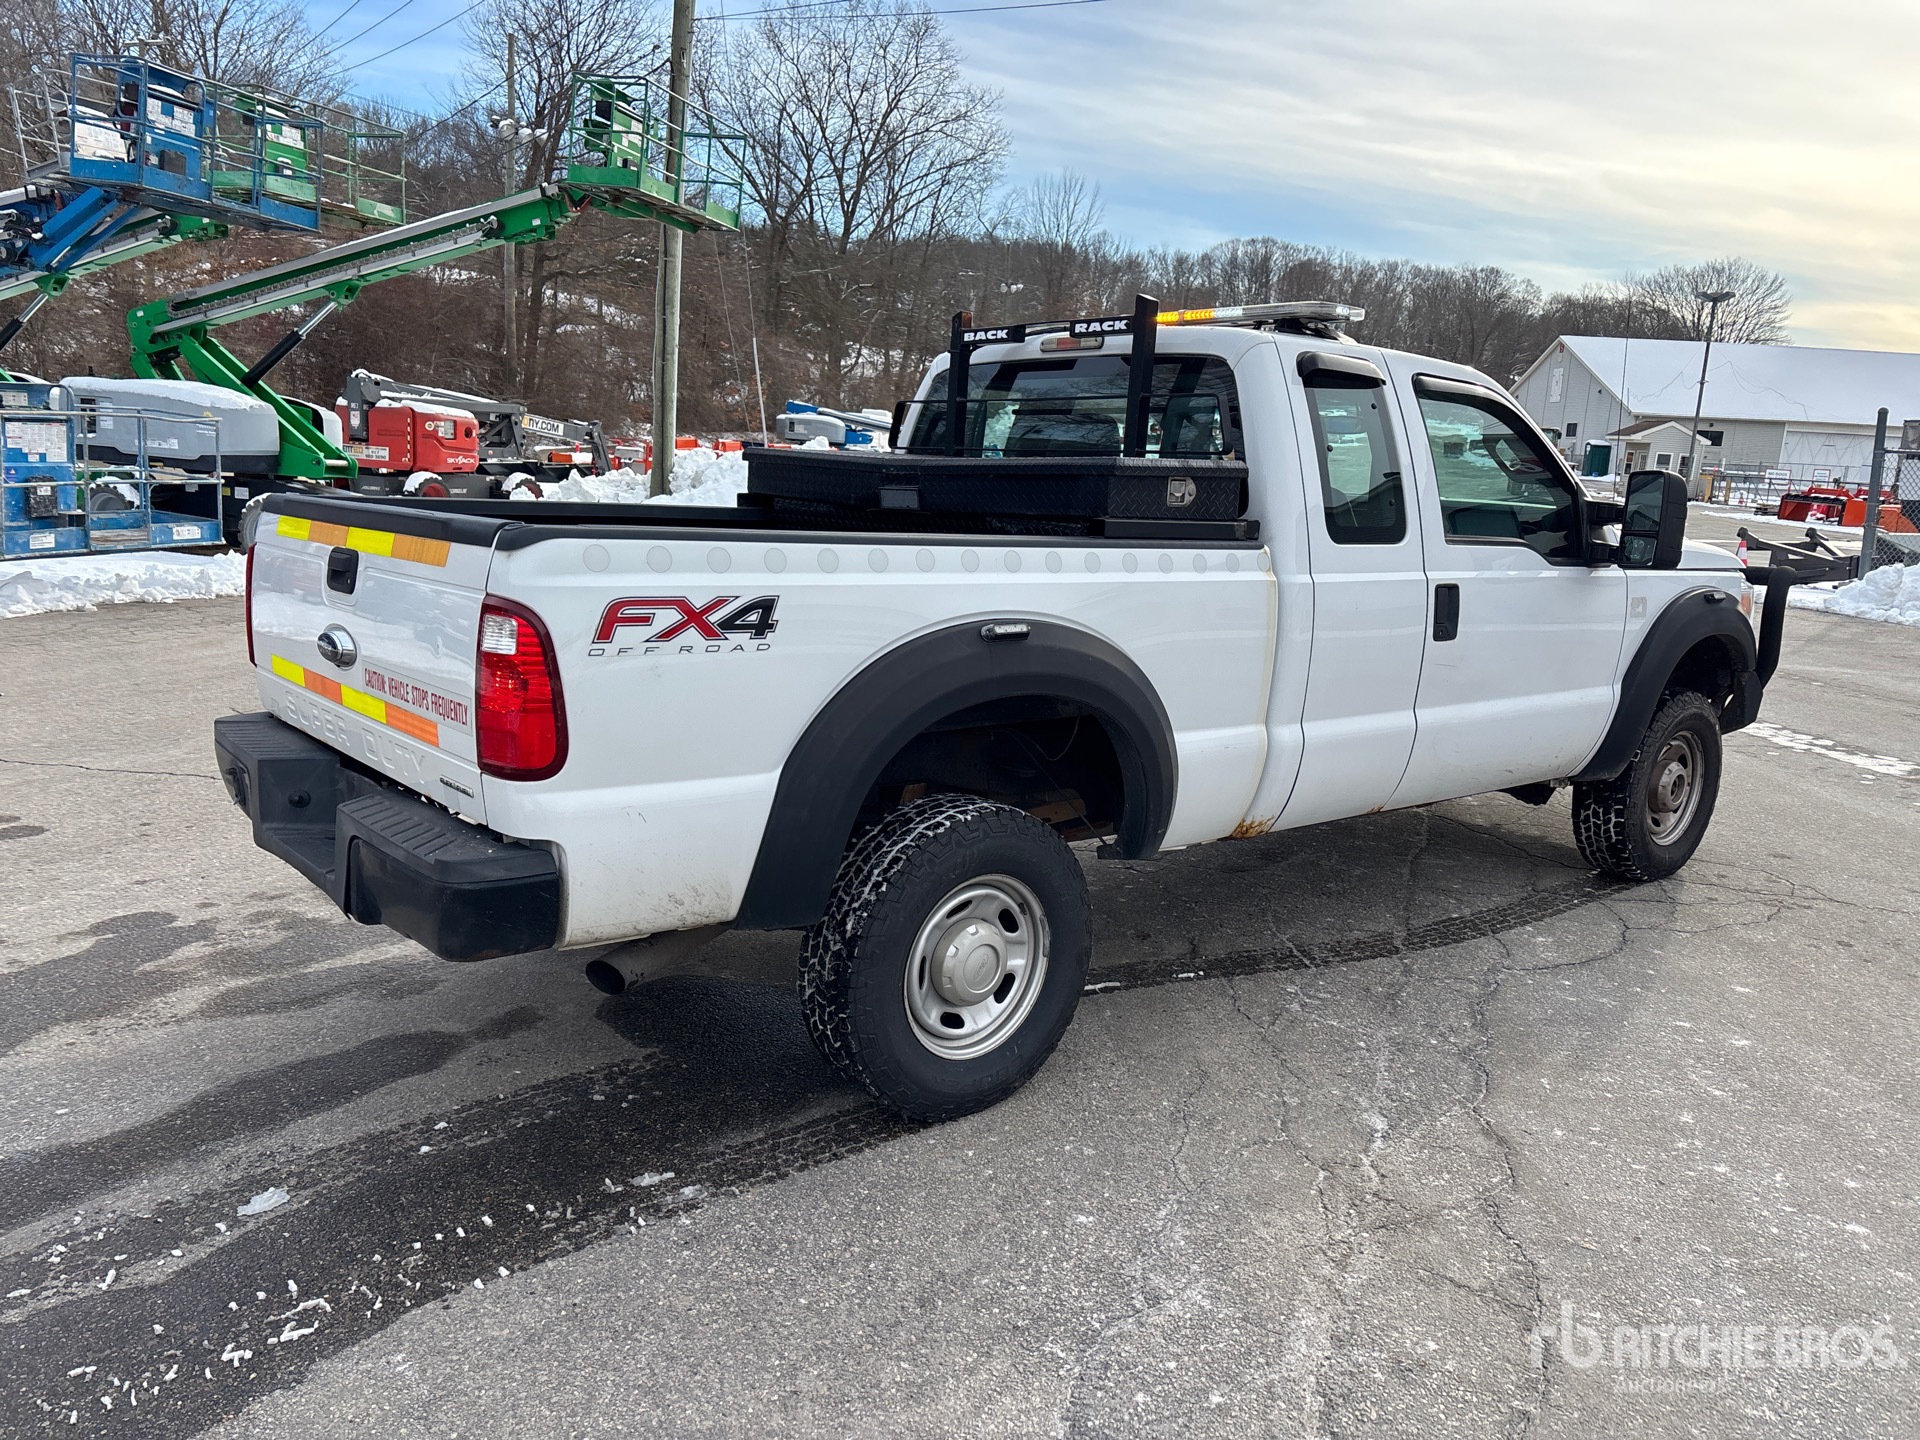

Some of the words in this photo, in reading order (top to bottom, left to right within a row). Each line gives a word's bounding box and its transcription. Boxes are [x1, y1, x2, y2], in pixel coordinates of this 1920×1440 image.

[963, 329, 1009, 342] BACK
[1074, 319, 1128, 333] RACK
[446, 455, 475, 464] SKYJACK
[592, 595, 779, 644] FX4
[588, 647, 660, 657] OFF
[679, 643, 771, 654] ROAD
[364, 667, 387, 694] CAUTION:
[387, 676, 410, 703] VEHICLE
[411, 685, 429, 711] STOPS
[430, 692, 468, 726] FREQUENTLY
[285, 690, 350, 747] SUPER
[361, 727, 425, 785] DUTY
